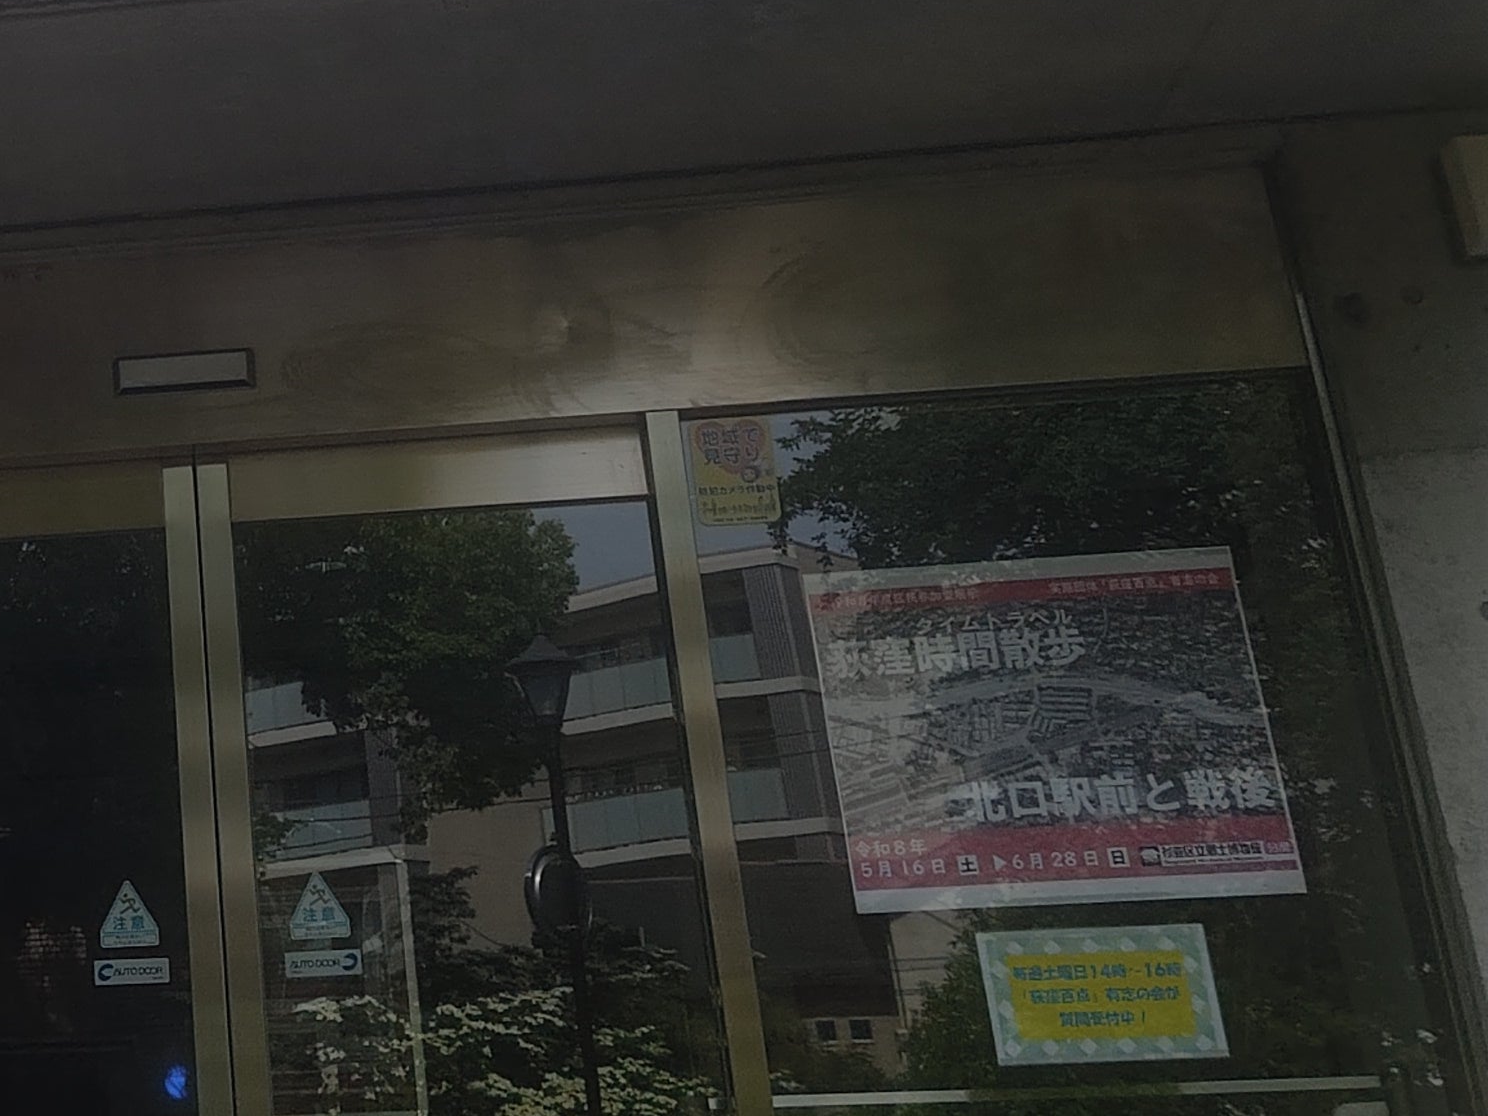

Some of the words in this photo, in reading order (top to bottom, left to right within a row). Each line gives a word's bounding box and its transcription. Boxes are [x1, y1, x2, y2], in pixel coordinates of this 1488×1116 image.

[916, 609, 1072, 635] タイムトラベル
[827, 627, 1086, 679] 荻窪時間散歩
[960, 767, 1276, 823] 北口駅前と戦後
[855, 839, 928, 858] 令和8年
[113, 915, 145, 930] 注意
[303, 906, 336, 922] 注意
